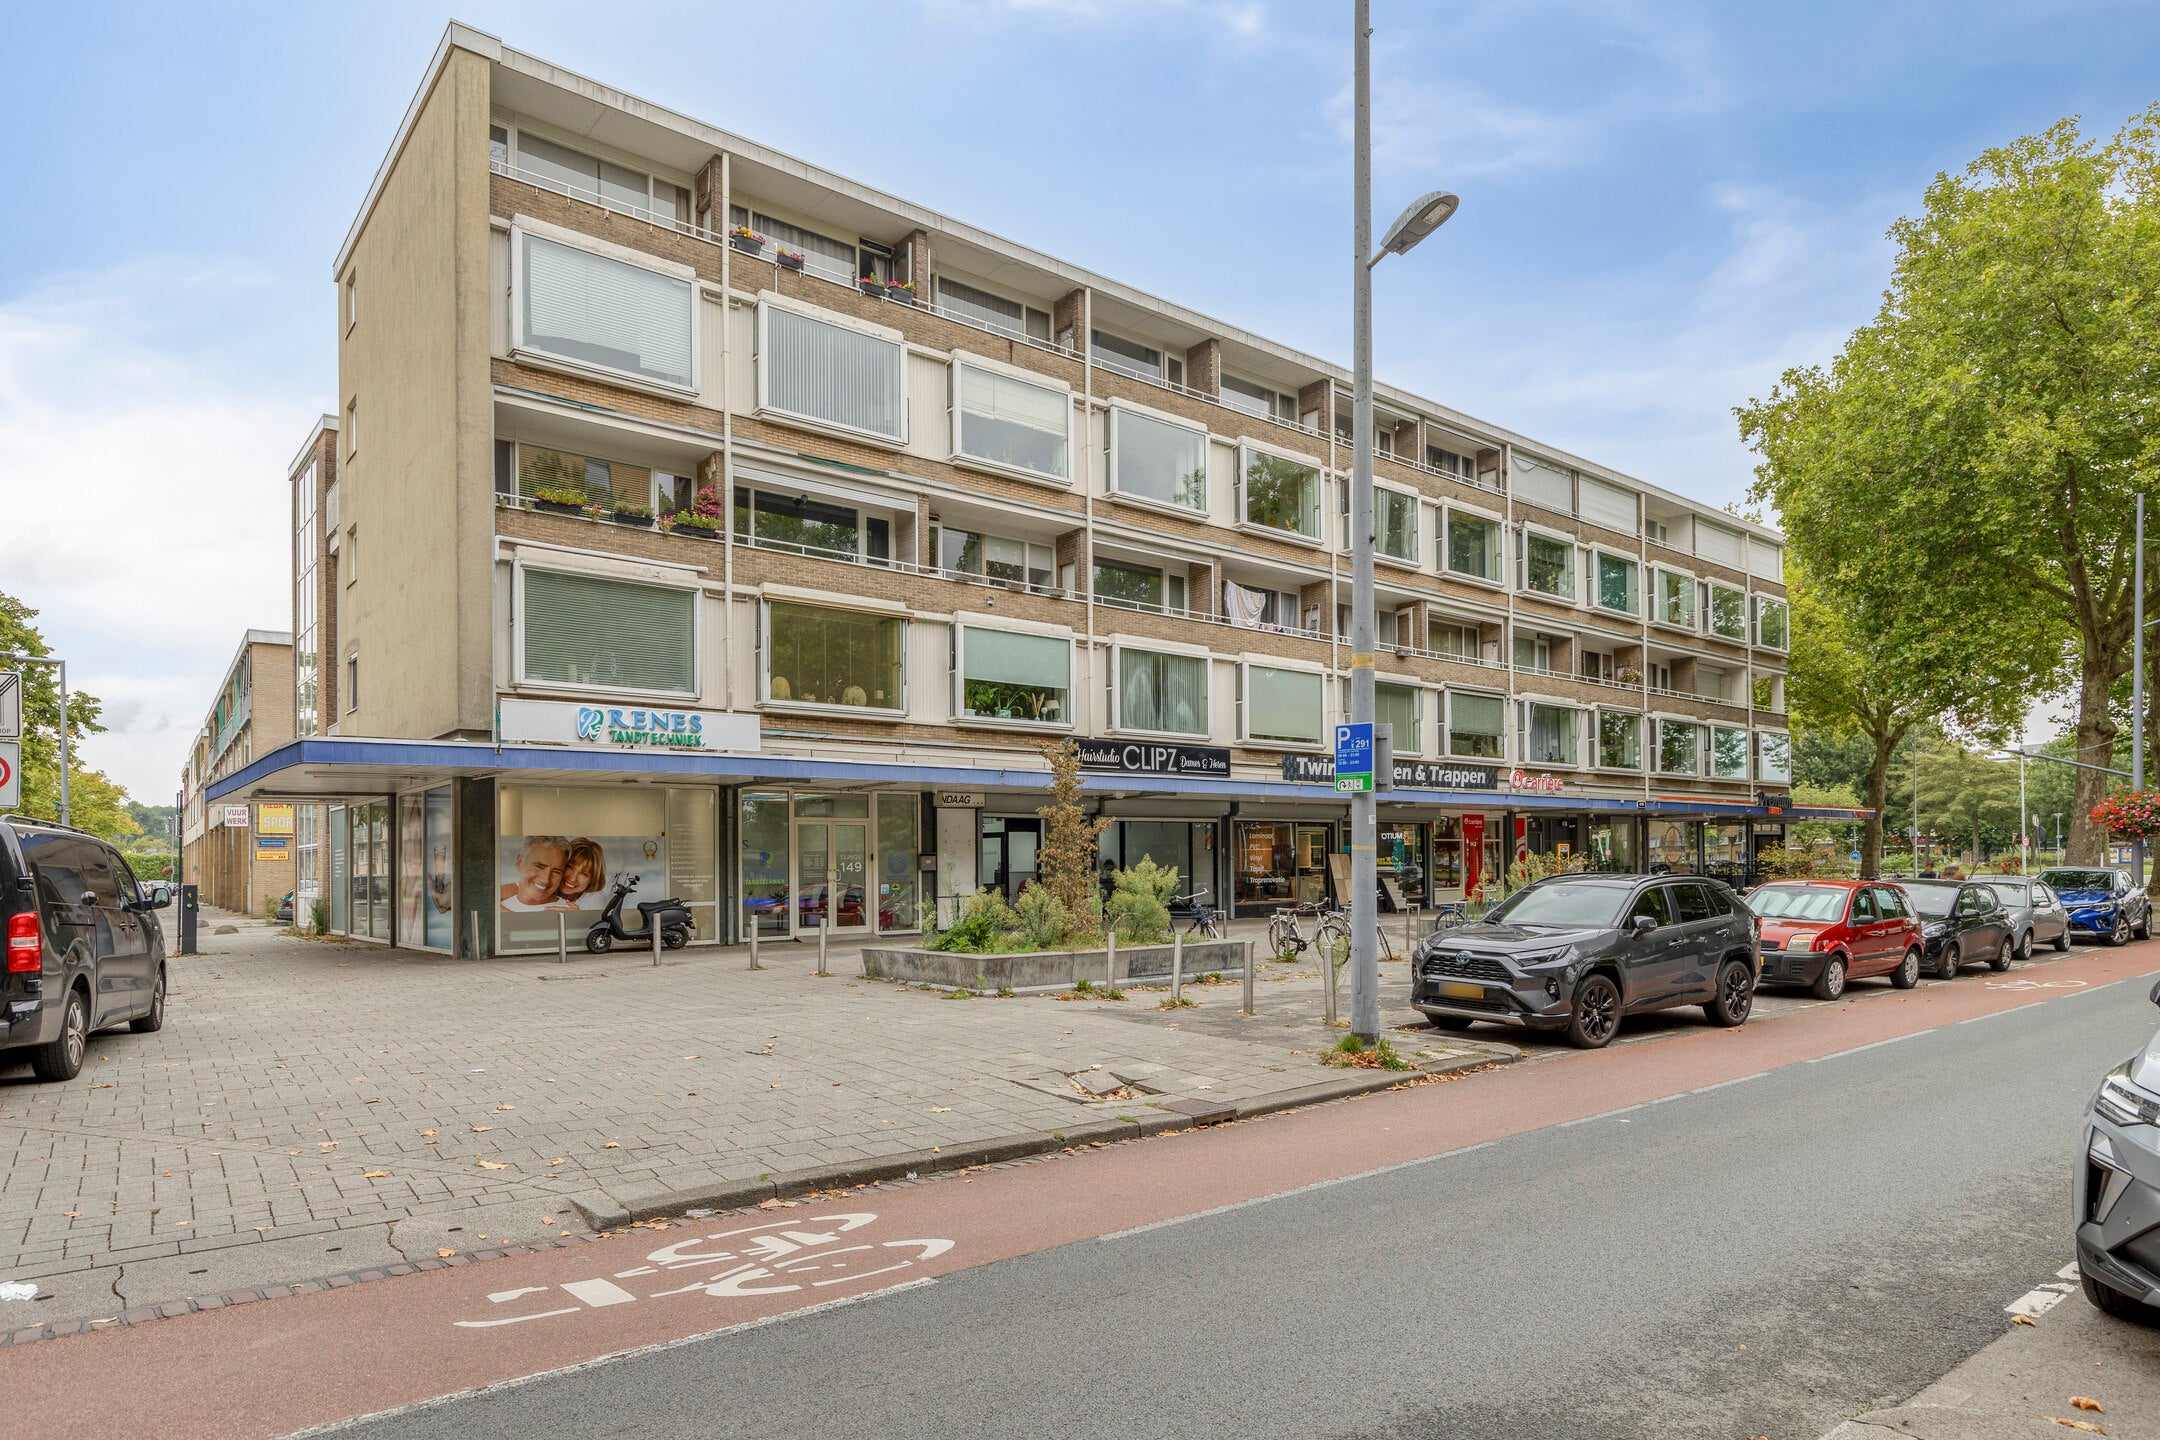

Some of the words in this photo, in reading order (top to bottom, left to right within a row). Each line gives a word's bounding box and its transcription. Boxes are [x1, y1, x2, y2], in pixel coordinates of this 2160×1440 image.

[607, 708, 704, 734] RENES
[609, 729, 702, 747] TANDTECHNIEK
[1337, 727, 1351, 750] P
[1355, 739, 1370, 749] 291
[1076, 748, 1120, 763] Hairstudio
[1122, 745, 1178, 772] CLIPZ
[1209, 757, 1227, 769] Heren
[1414, 764, 1426, 781] &
[1428, 765, 1486, 787] Trappen
[226, 817, 247, 825] WERK
[840, 861, 862, 873] 149
